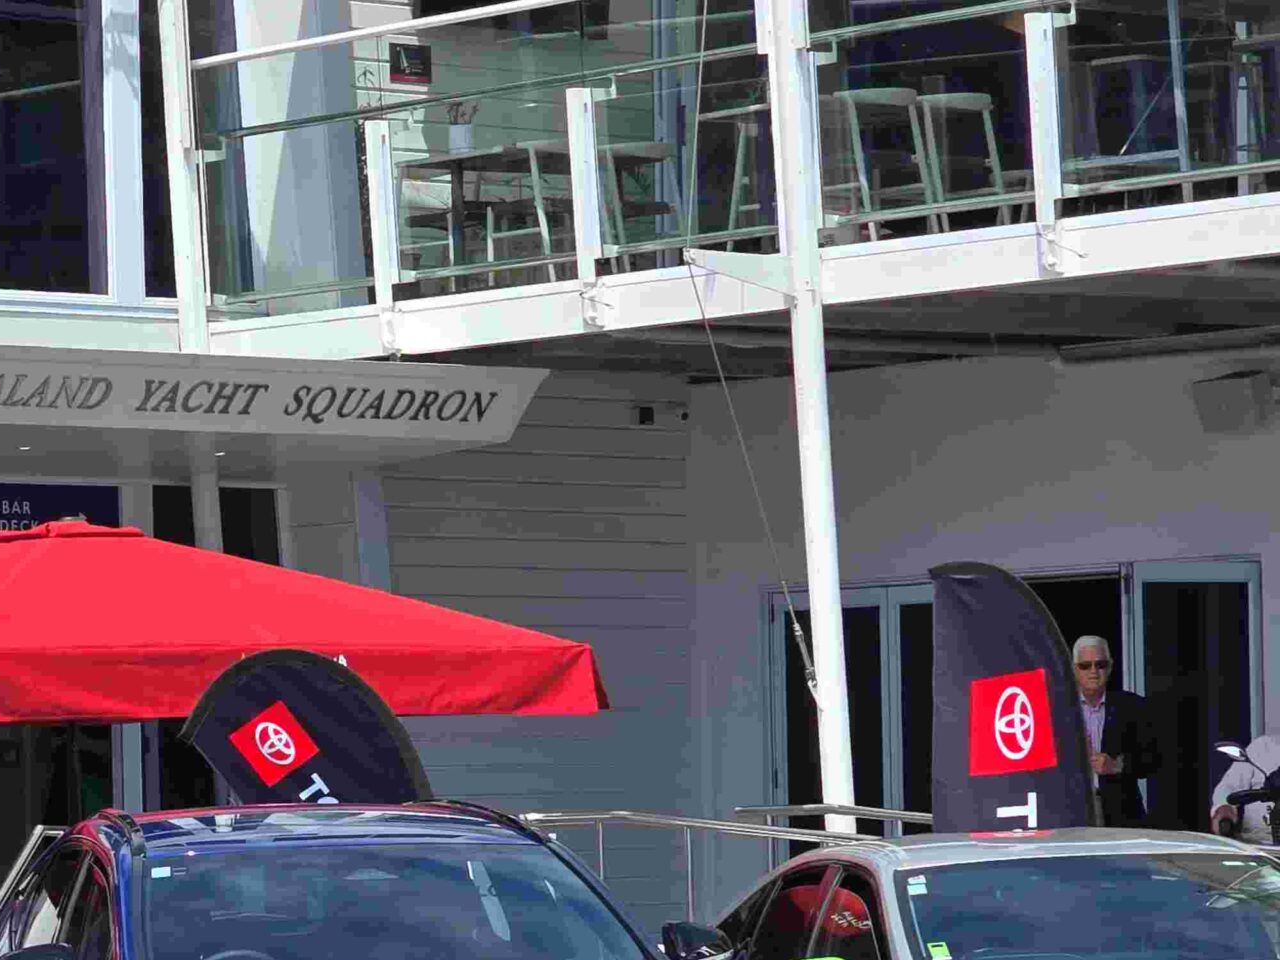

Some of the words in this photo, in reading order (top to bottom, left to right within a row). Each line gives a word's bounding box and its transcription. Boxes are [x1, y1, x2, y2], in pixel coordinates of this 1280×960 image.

[135, 379, 268, 415] YACHT
[283, 385, 497, 423] SQUADRON
[2, 501, 31, 515] BAR
